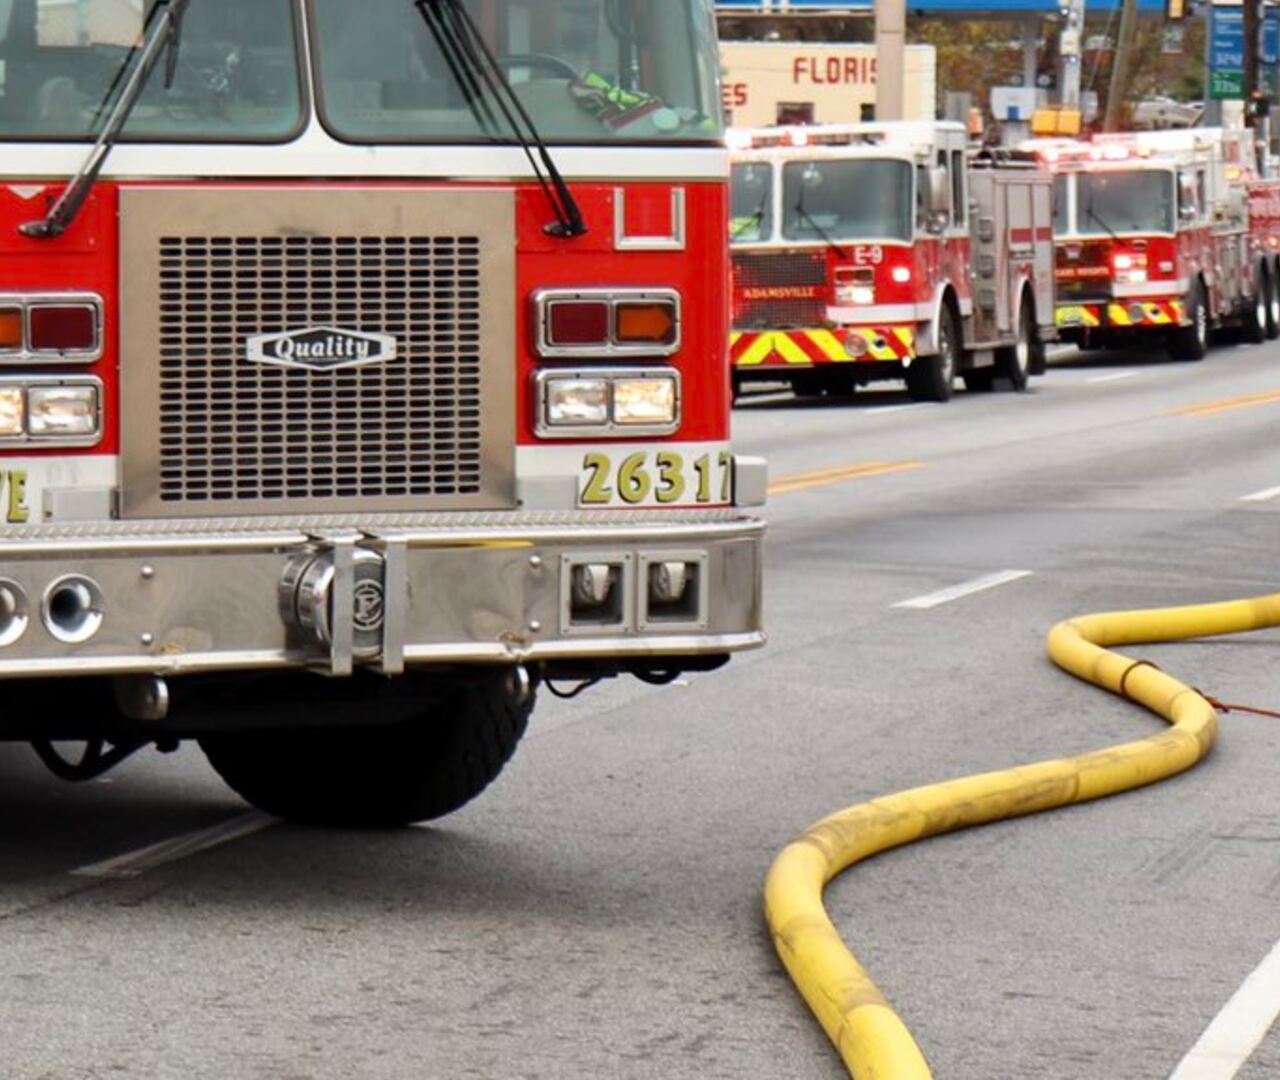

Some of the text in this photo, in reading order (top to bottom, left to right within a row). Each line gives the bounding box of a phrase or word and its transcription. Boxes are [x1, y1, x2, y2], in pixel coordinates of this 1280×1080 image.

[743, 286, 816, 299] ADAMSVILLE
[275, 335, 370, 361] Quality
[580, 451, 731, 504] 26317
